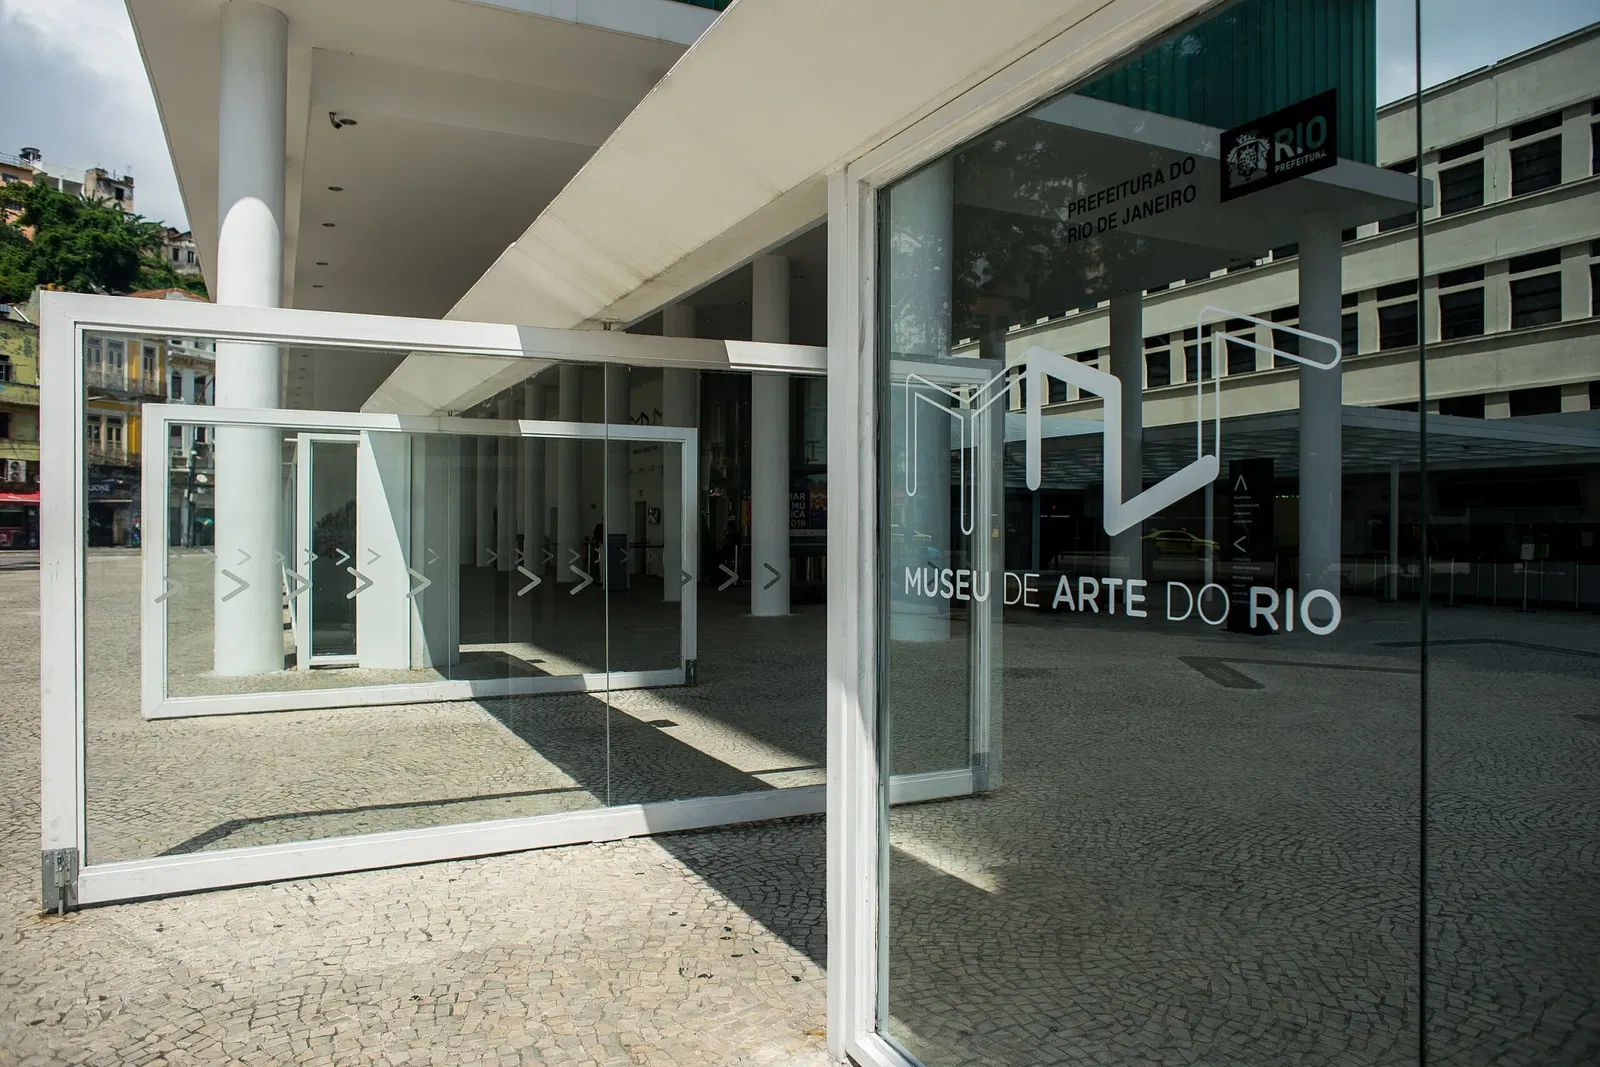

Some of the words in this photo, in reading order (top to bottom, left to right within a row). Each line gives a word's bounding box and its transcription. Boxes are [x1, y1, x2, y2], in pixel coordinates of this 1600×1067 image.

[1274, 115, 1327, 163] RIO
[1274, 150, 1327, 173] PREFEITURA
[1068, 170, 1165, 218] PREFEITURA
[1170, 156, 1196, 181] DO
[1068, 221, 1093, 244] RIO
[1097, 213, 1118, 235] DE
[1122, 185, 1197, 226] JANEIRO
[789, 510, 806, 518] ICA
[789, 519, 806, 528] 018
[904, 566, 990, 602] MUSEU
[1003, 572, 1040, 608] DE
[1052, 575, 1148, 618] ARTE
[1166, 581, 1230, 626] DO
[1249, 586, 1342, 636] RIO
